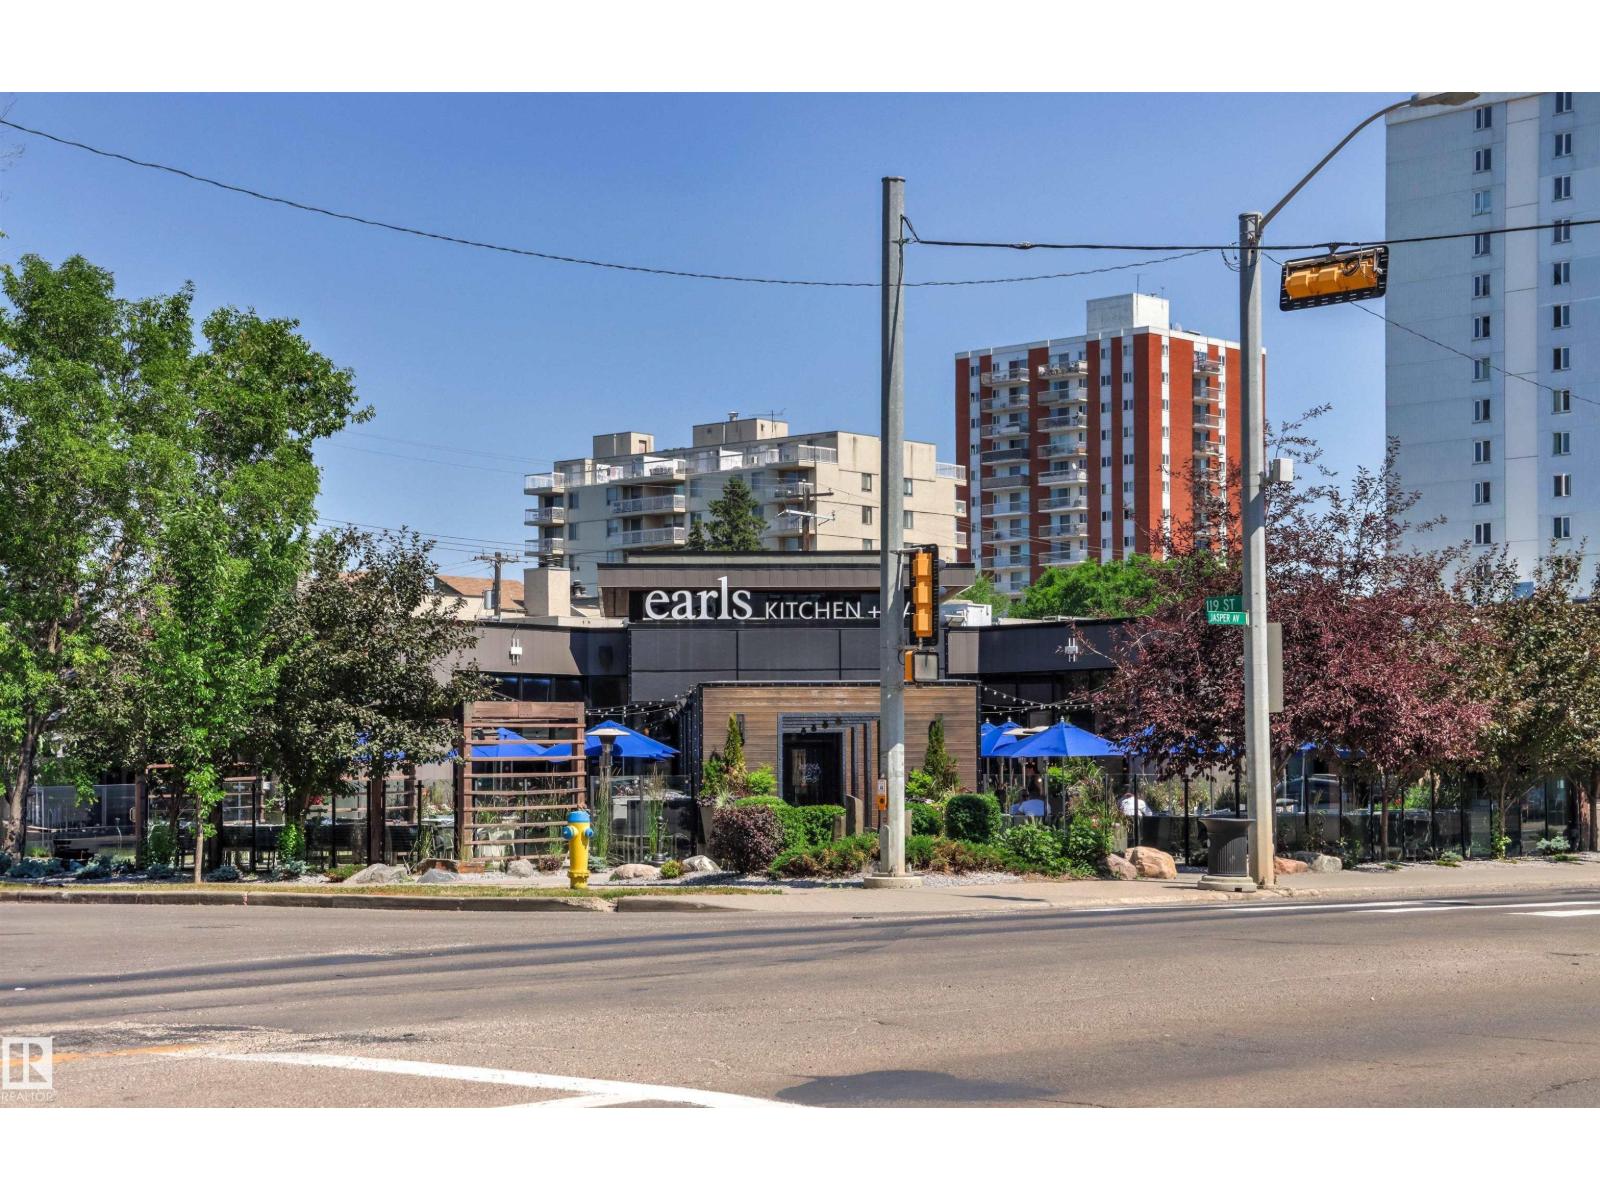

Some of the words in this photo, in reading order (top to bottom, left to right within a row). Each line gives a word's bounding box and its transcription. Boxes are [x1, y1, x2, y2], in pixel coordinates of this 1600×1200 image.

[645, 576, 753, 620] earls
[765, 601, 861, 620] KITCHEN
[1206, 599, 1219, 611] 119
[1223, 598, 1235, 611] ST
[1210, 613, 1230, 623] JASPER
[1232, 614, 1240, 623] AV
